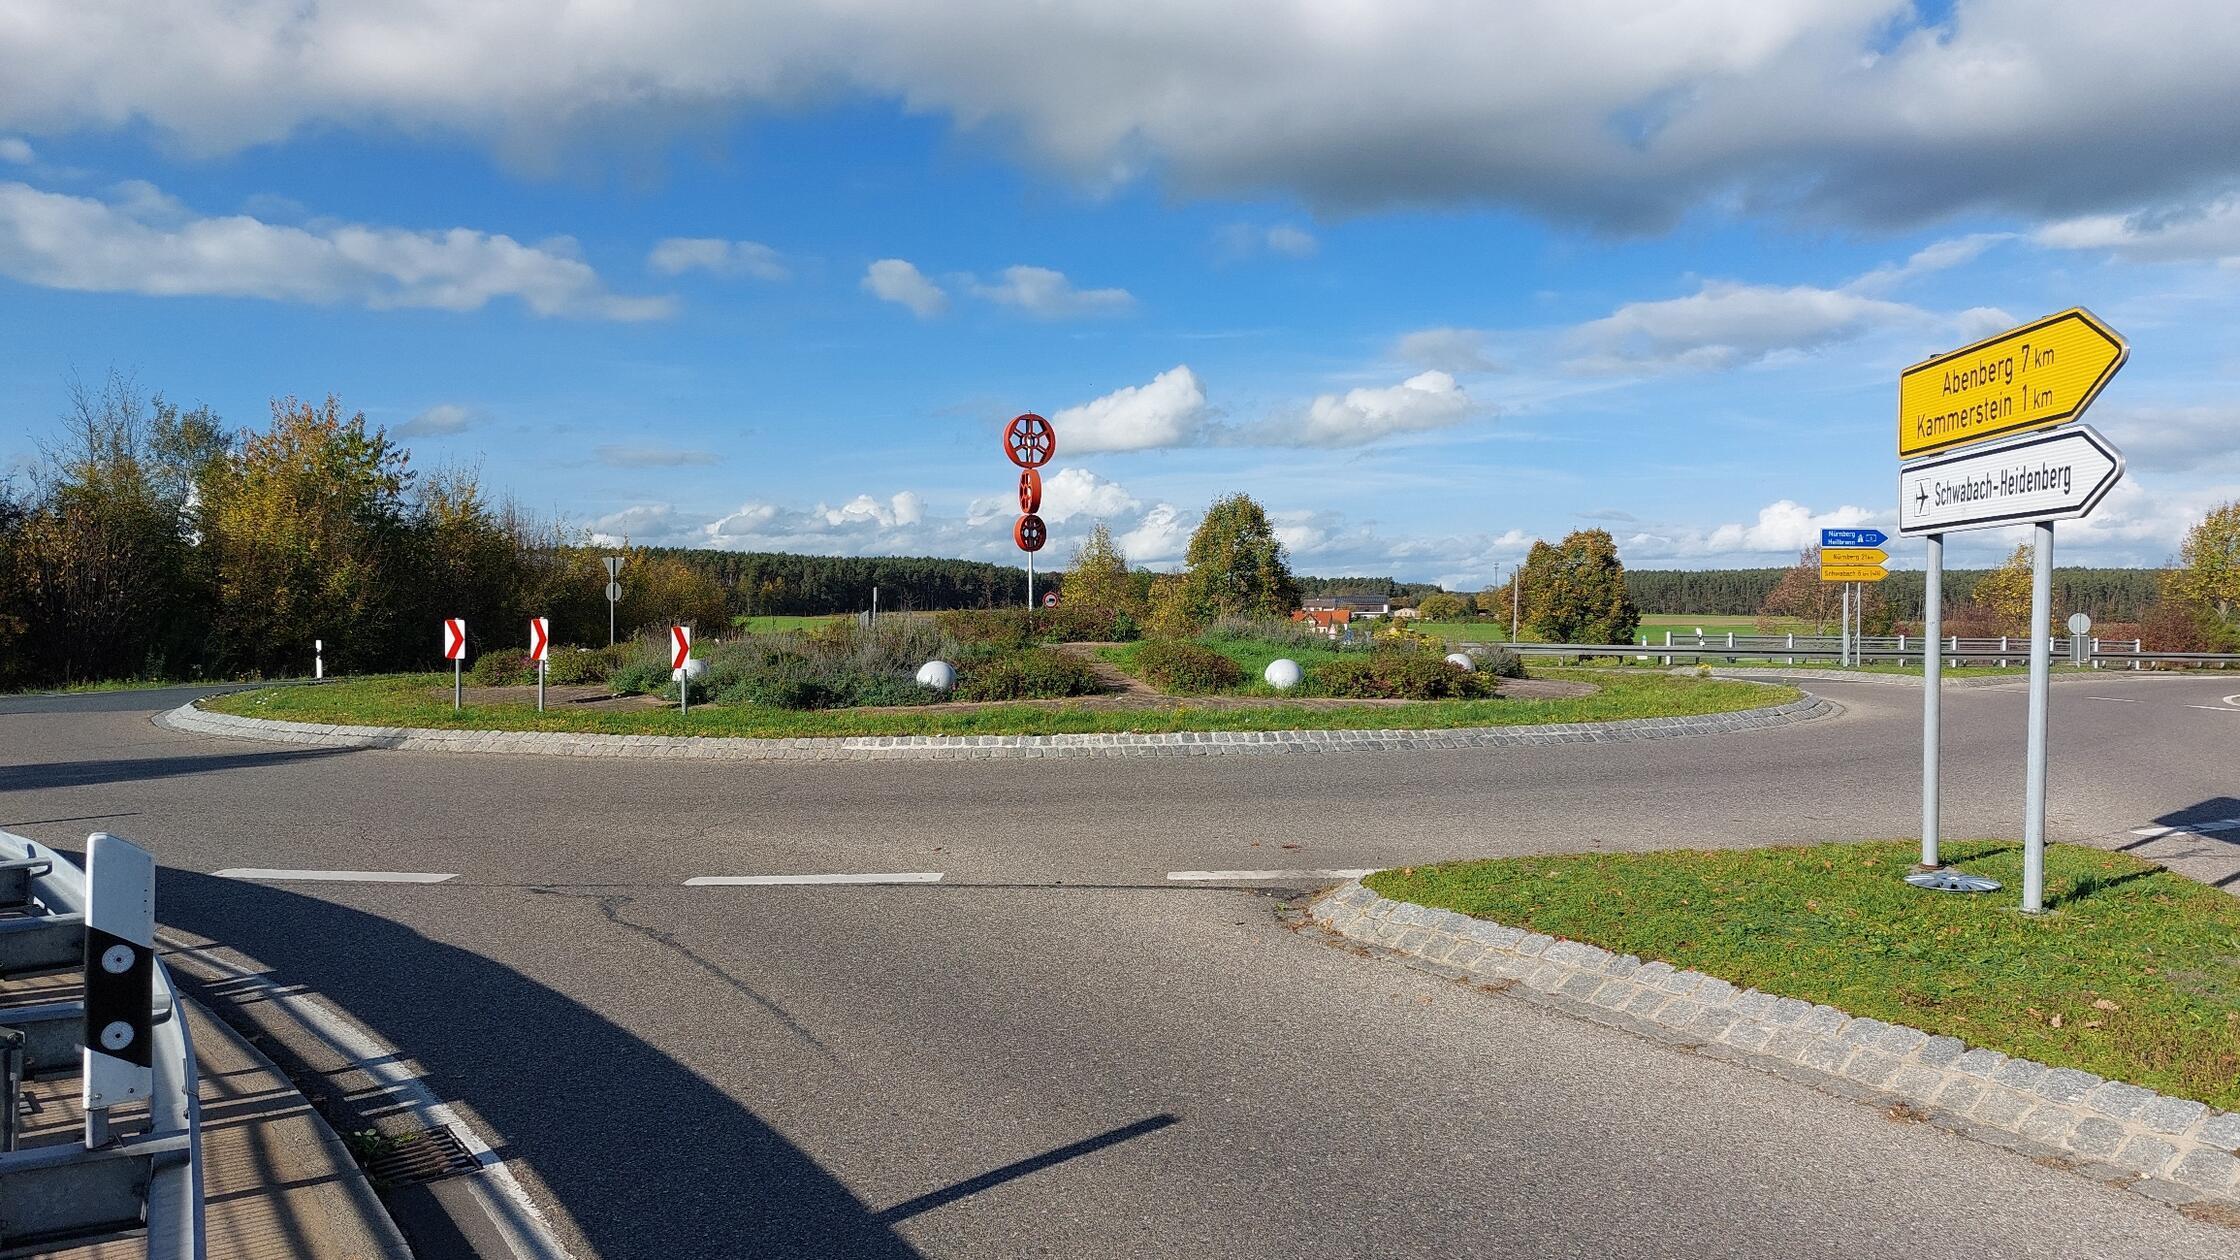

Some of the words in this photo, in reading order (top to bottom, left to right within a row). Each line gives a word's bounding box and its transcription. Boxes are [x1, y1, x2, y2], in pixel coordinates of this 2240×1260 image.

[1942, 355, 2013, 397] Abenberg
[2021, 343, 2031, 373] 7
[2034, 347, 2055, 369] km
[1917, 392, 2012, 440] Kammerstein
[2021, 383, 2028, 412] 1
[2033, 387, 2053, 410] km
[1934, 462, 2072, 507] Schwabach-Heidenberg
[1828, 530, 1856, 538] Nürnberg
